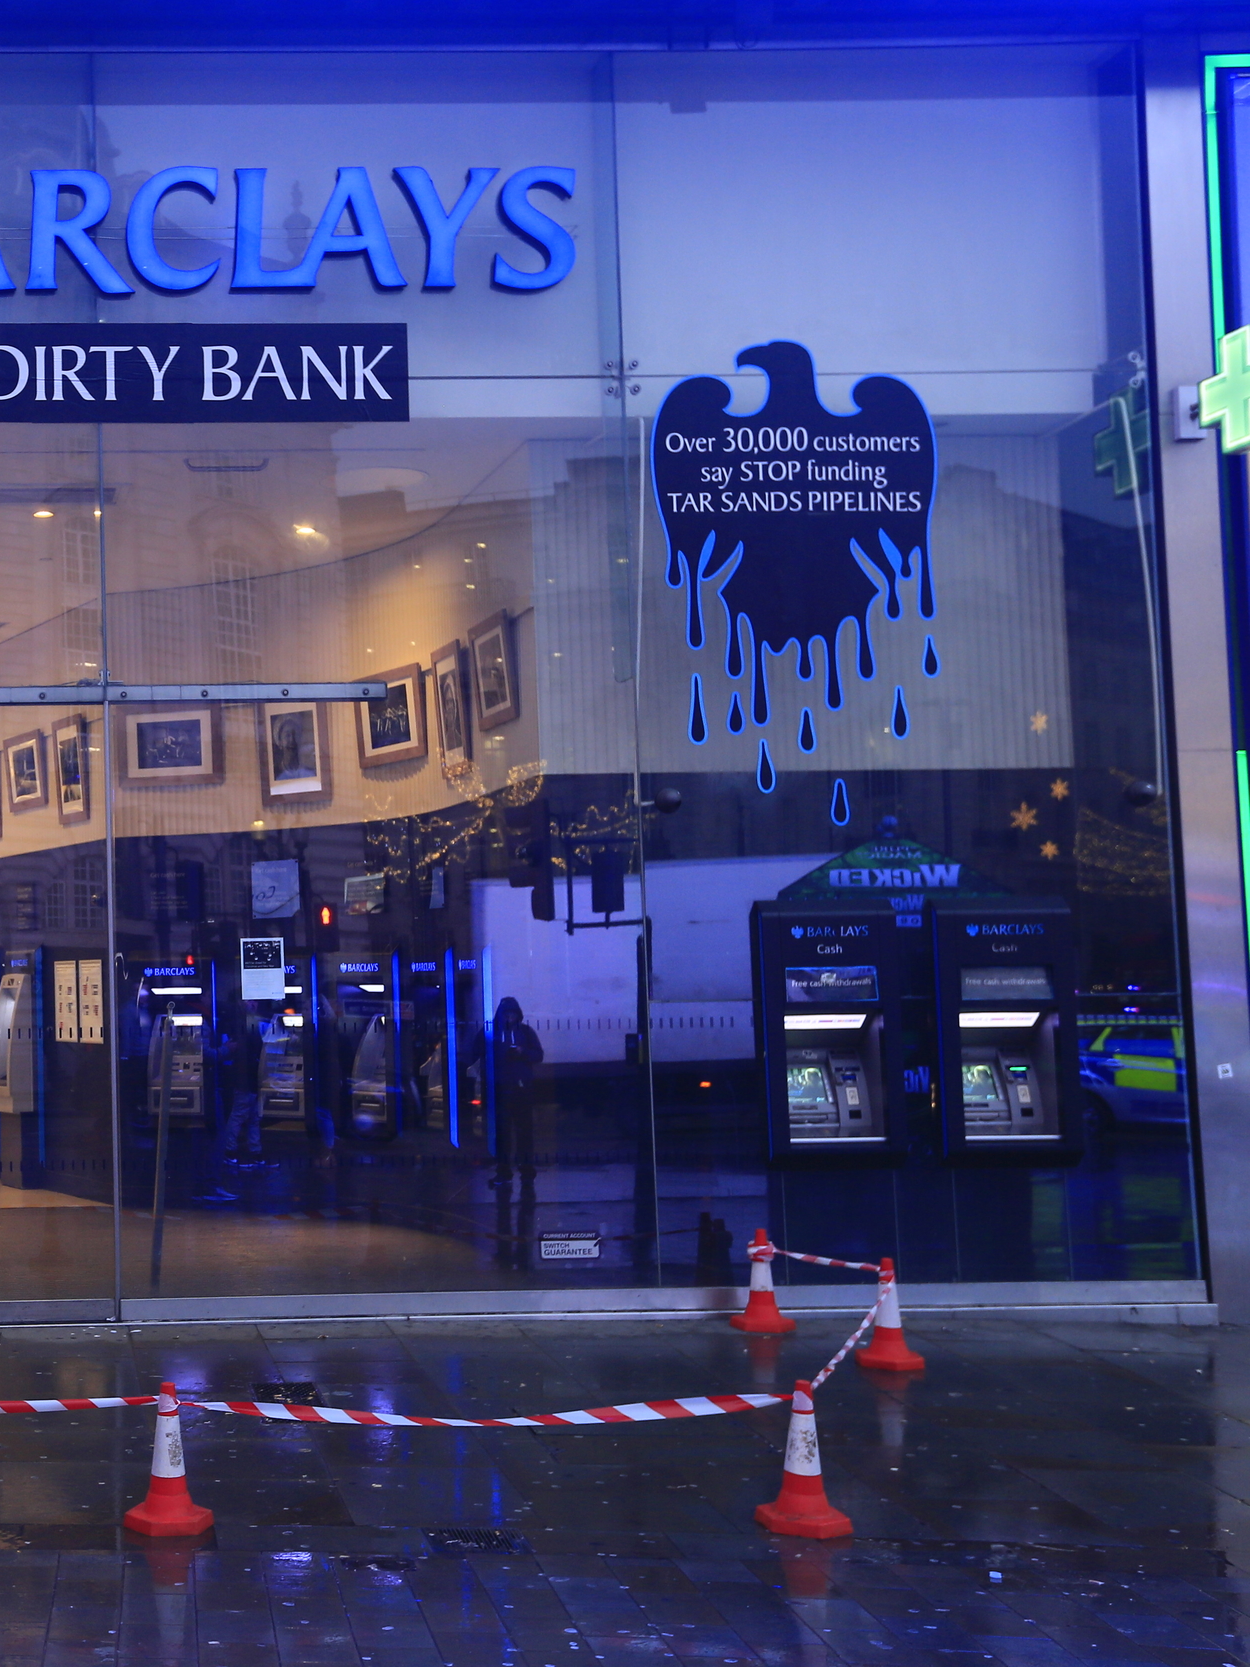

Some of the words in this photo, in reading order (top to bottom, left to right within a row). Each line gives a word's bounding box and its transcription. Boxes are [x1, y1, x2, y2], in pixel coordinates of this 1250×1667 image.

[200, 344, 395, 402] BANK
[664, 432, 717, 453] Over
[722, 426, 809, 455] 30,000
[812, 432, 921, 452] customers
[700, 465, 734, 490] say
[739, 460, 801, 482] STOP
[806, 459, 889, 490] funding
[667, 492, 715, 513] TAR
[720, 491, 803, 513] SANDS
[807, 490, 923, 513] PIPELINES
[807, 925, 869, 938] BARLAYS
[981, 923, 1046, 936] BARCLAYS
[817, 943, 843, 954] Cash
[991, 943, 1018, 953] Cash
[154, 967, 195, 977] BARCLAYS
[347, 963, 379, 973] BARCLAYS
[791, 979, 808, 988] Free
[543, 1248, 593, 1256] GUARANTEE
